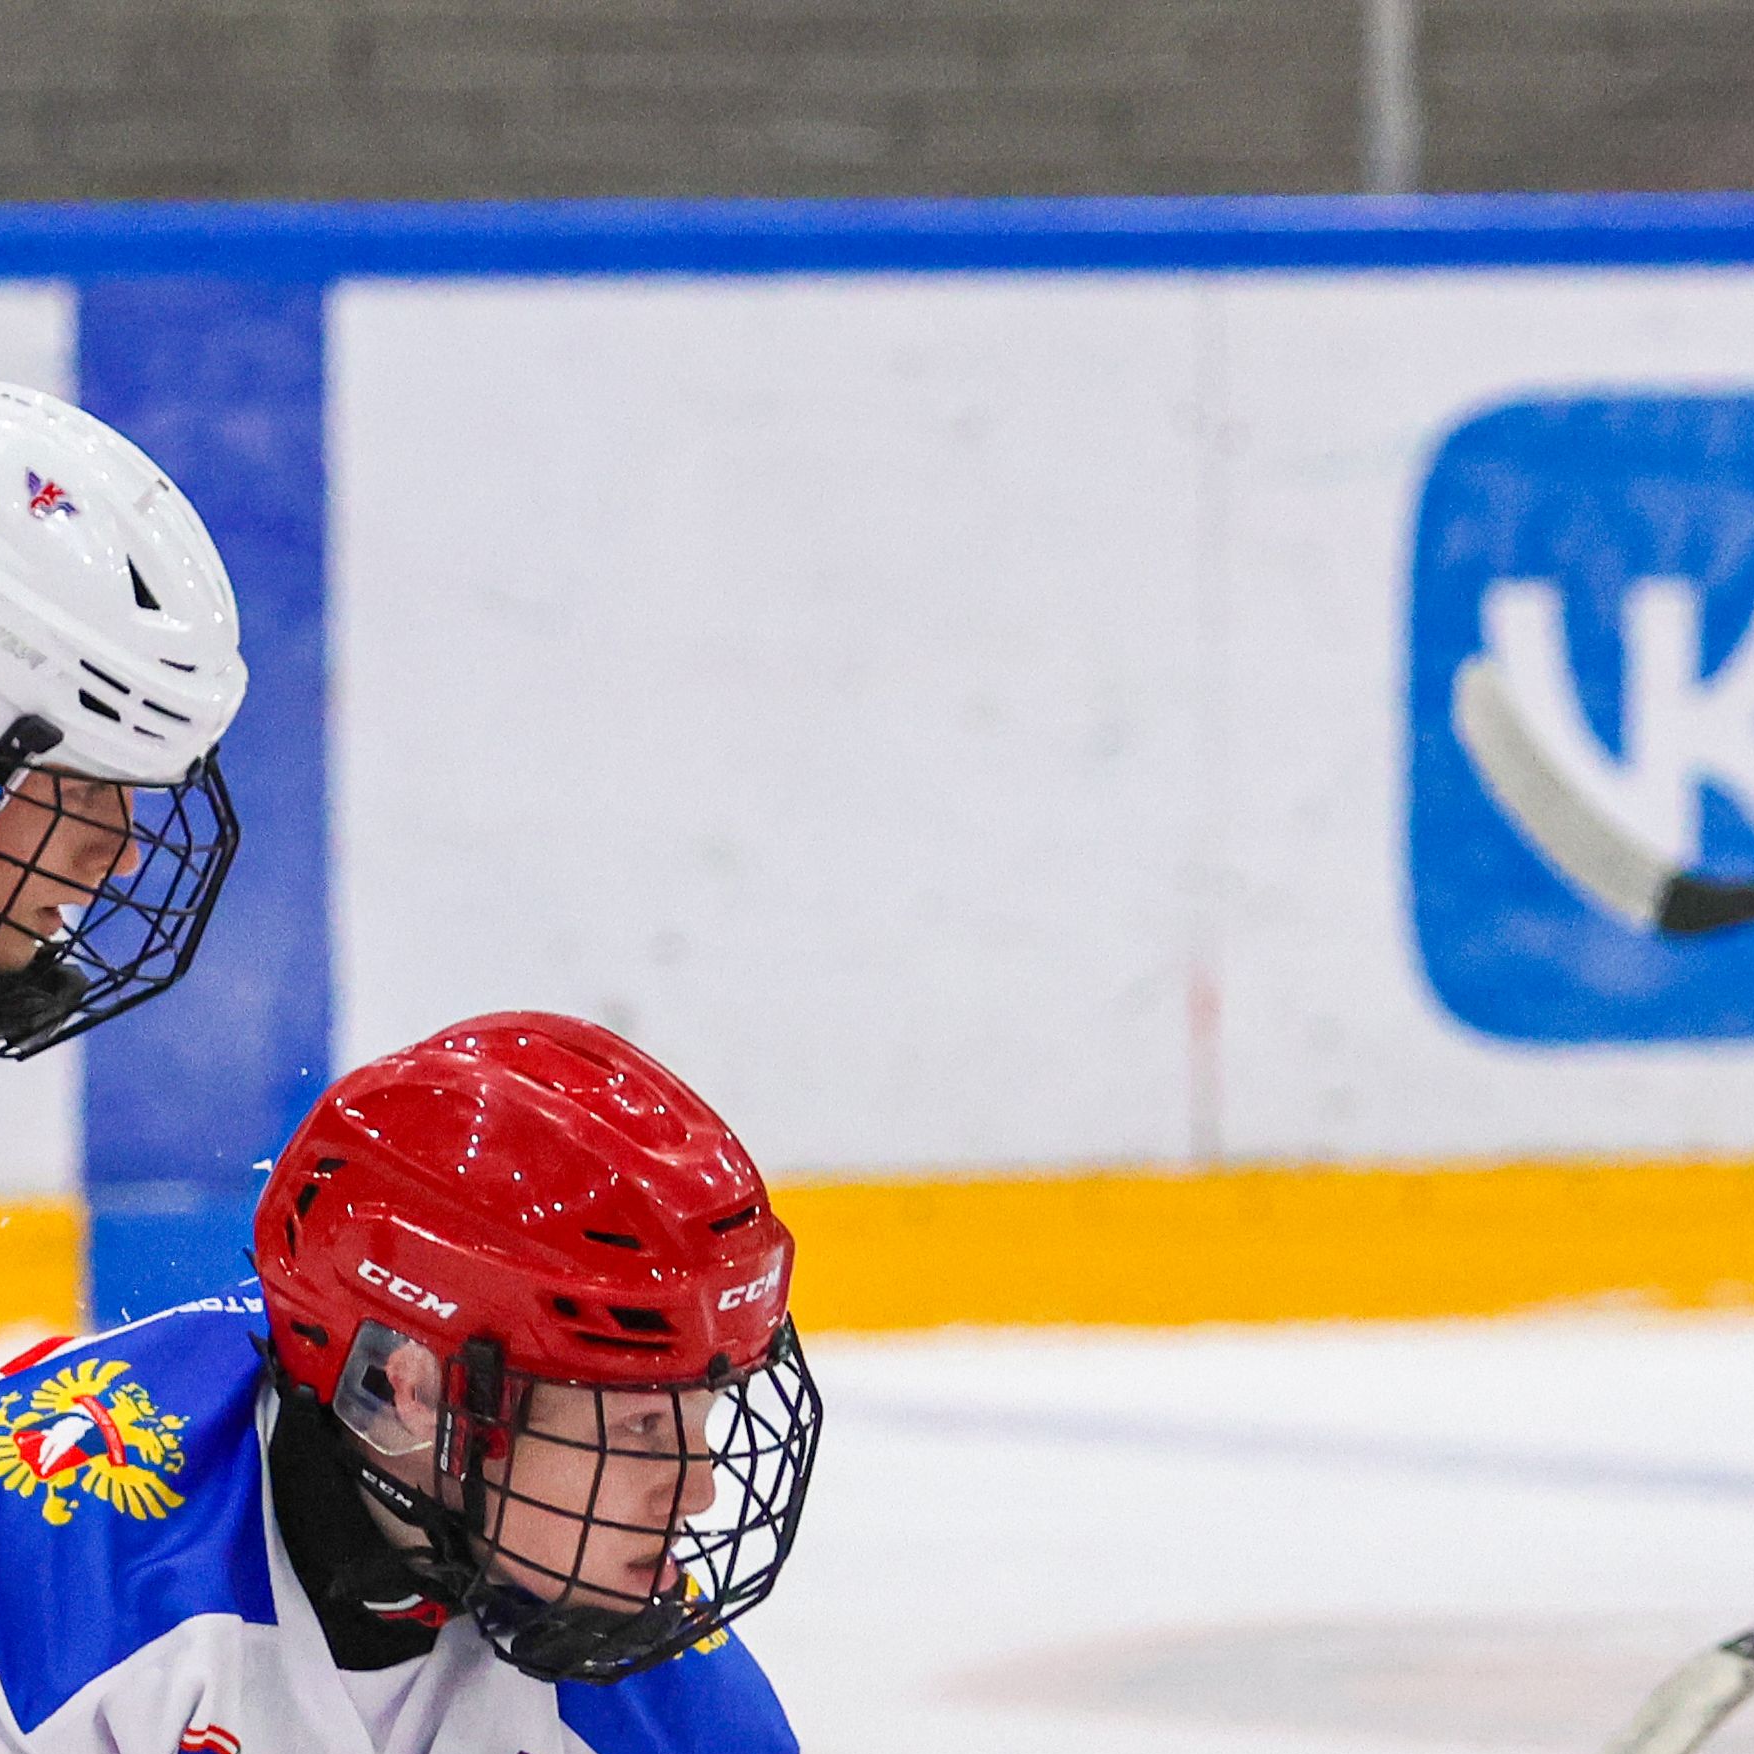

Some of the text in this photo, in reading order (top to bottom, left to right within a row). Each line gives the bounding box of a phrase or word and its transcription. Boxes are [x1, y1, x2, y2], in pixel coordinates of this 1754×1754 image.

[357, 1258, 459, 1320] CCM
[717, 1265, 782, 1312] CCM
[361, 1468, 414, 1509] CCM
